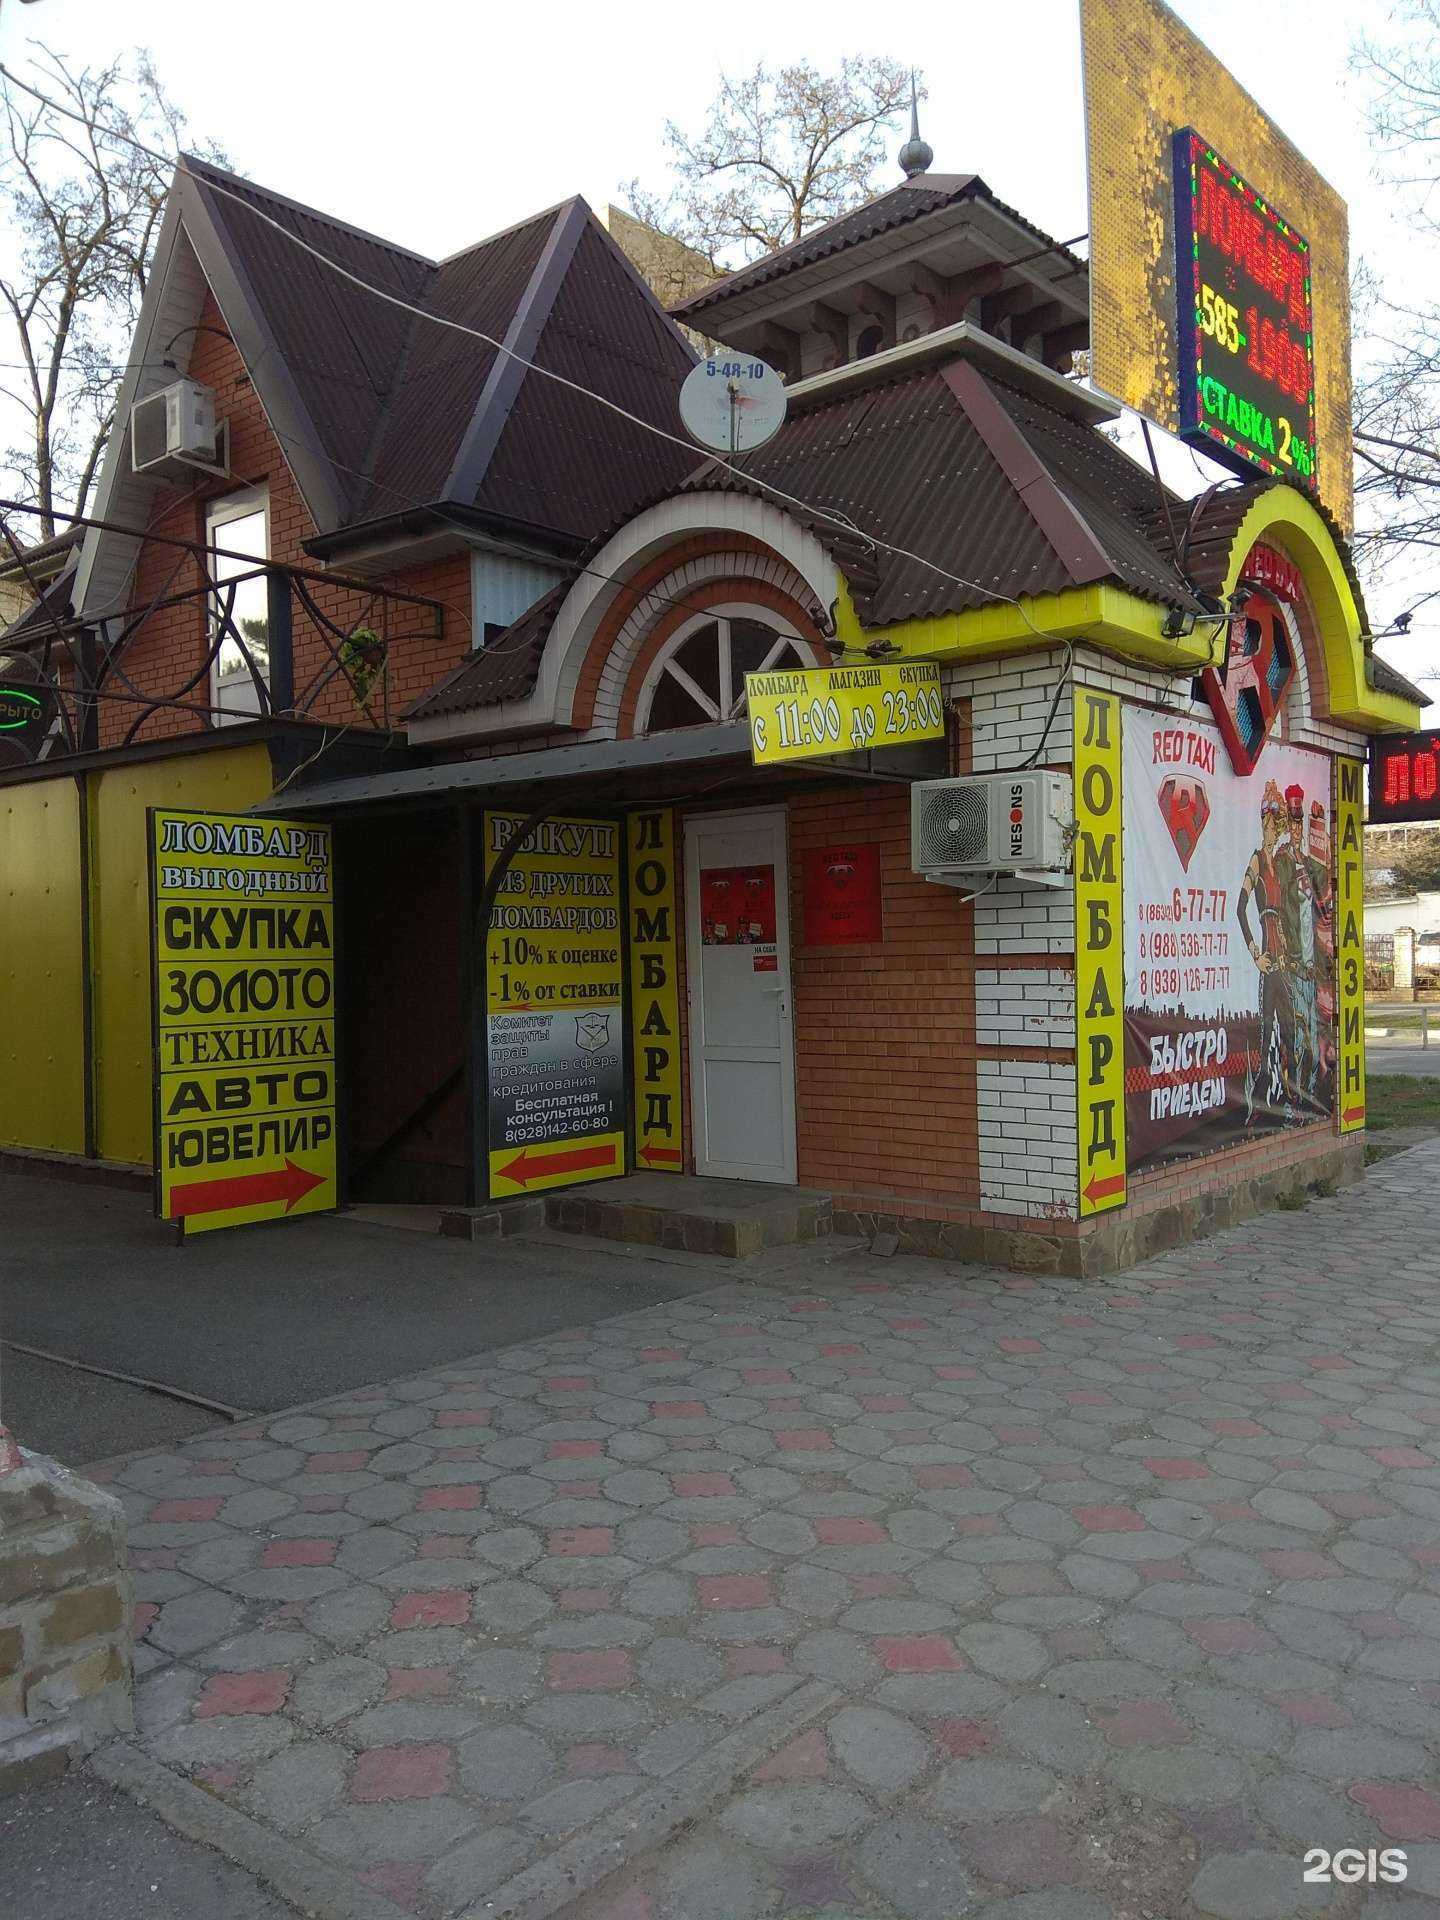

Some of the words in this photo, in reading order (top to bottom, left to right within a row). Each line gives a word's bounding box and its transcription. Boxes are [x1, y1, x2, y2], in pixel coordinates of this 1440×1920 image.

[706, 361, 764, 379] 5-48-10
[1202, 375, 1275, 455] СТАВКА
[749, 674, 808, 697] ЛОМБАРД
[828, 669, 881, 690] МАГАЗИН
[900, 665, 938, 687] СКУПКА
[775, 696, 840, 748] 11:00
[882, 687, 941, 734] 23:00
[1152, 729, 1184, 764] RED
[1187, 733, 1215, 775] TAXI
[492, 818, 615, 857] ВЫКУП
[1010, 784, 1023, 856] NESONS
[161, 821, 328, 865] ЛОМБАРД
[499, 870, 525, 893] ИЗ
[529, 872, 614, 899] ДРУГИХ
[164, 906, 330, 950] СКУПКА
[489, 906, 617, 934] ЛОМБАРДОВ
[1079, 695, 1117, 1166] ЛОМБАРД
[1341, 763, 1360, 1093] МАГАЗИН
[561, 948, 617, 966] оценке
[1181, 933, 1228, 957] 536-77-77
[163, 968, 331, 1015] ЗОЛОТО
[534, 985, 555, 999] от
[560, 982, 620, 998] ставки
[634, 814, 671, 1137] ЛОМБАРД
[1151, 968, 1180, 1000] (938)
[1184, 966, 1230, 992] 126-77-77
[490, 1015, 553, 1030] Комитет
[490, 1030, 550, 1045] защиты
[165, 1025, 332, 1065] ТЕХНИКА
[491, 1046, 529, 1062] прав
[1150, 1027, 1227, 1075] БЫСТРО
[492, 1061, 556, 1079] граждан
[573, 1054, 618, 1070] сфере
[167, 1071, 328, 1116] АВТО
[493, 1076, 596, 1099] кредитования
[515, 1092, 598, 1111] Бесплатная
[169, 1115, 332, 1169] ЮВЕЛИР
[505, 1117, 609, 1143] 8(928)142-60-80
